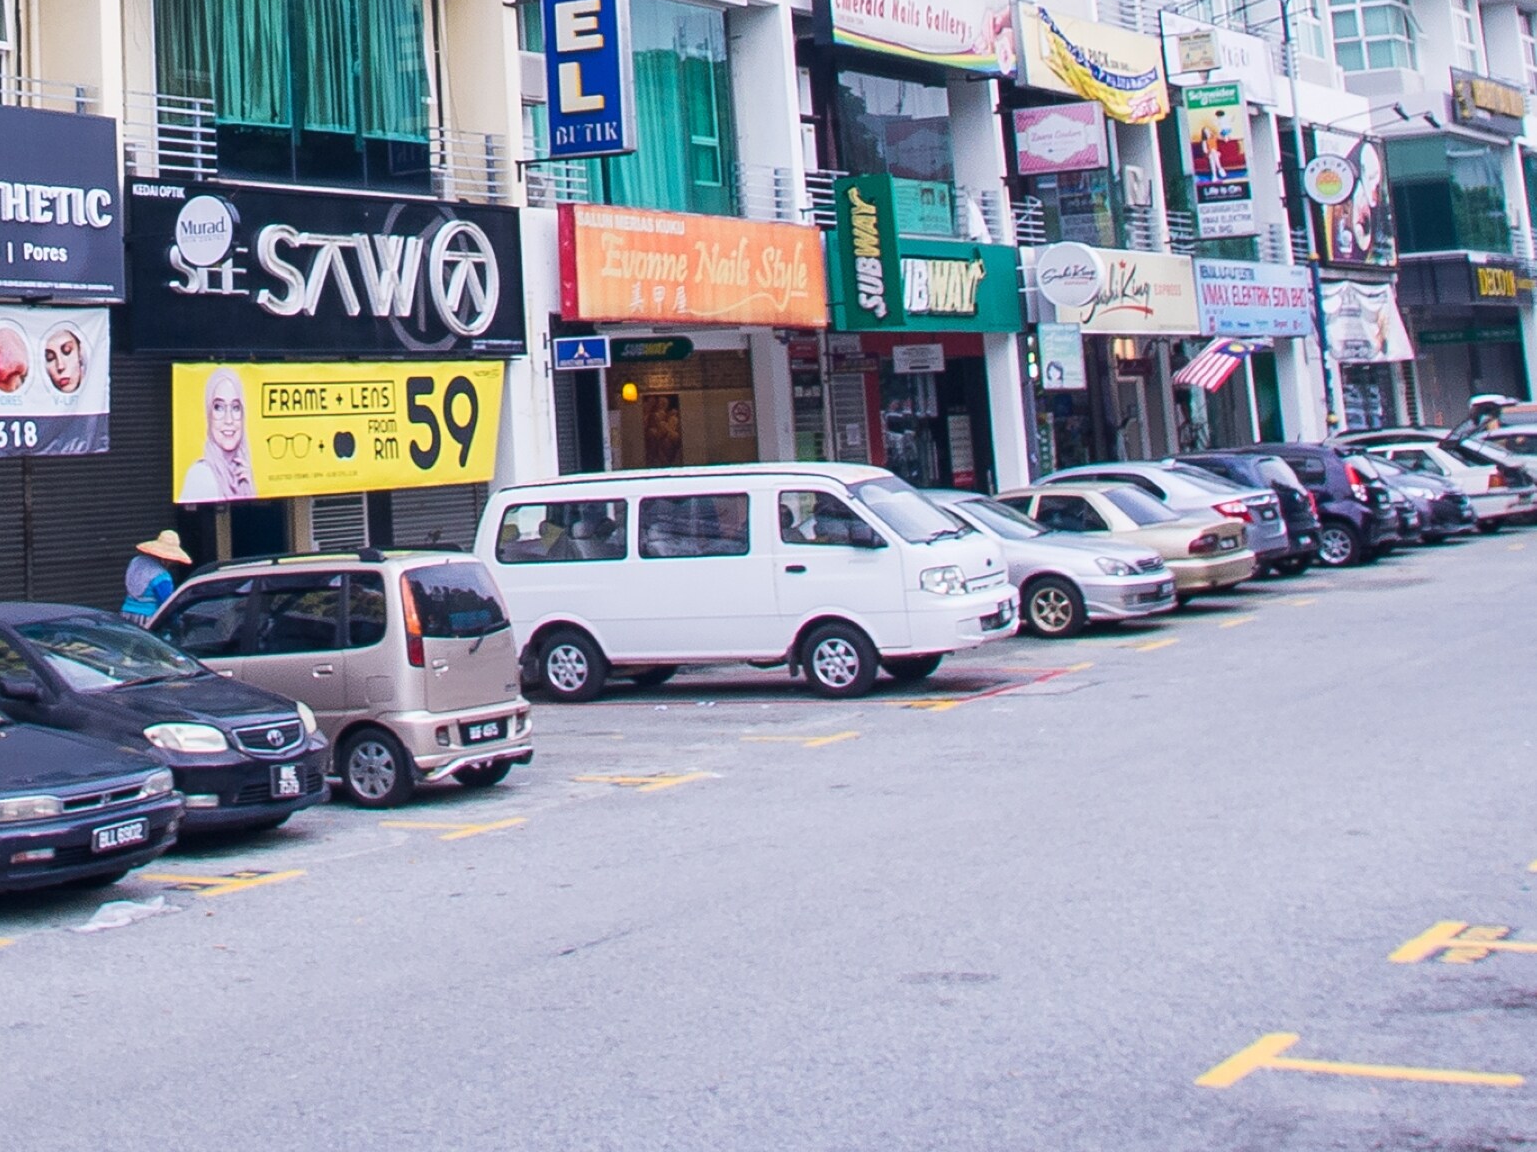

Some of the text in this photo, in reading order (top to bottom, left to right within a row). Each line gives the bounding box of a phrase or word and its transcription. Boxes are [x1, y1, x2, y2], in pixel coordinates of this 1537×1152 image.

[132, 183, 185, 198] KEDAI OPTIK
[180, 216, 226, 236] Murad
[23, 241, 68, 263] Pores
[848, 186, 887, 318] SUBWAY
[601, 232, 808, 312] Evonne Nails Style
[267, 388, 327, 410] FRAME
[351, 386, 391, 409] LENS
[406, 375, 479, 470] 59
[368, 420, 397, 434] FROM
[374, 437, 399, 460] RM
